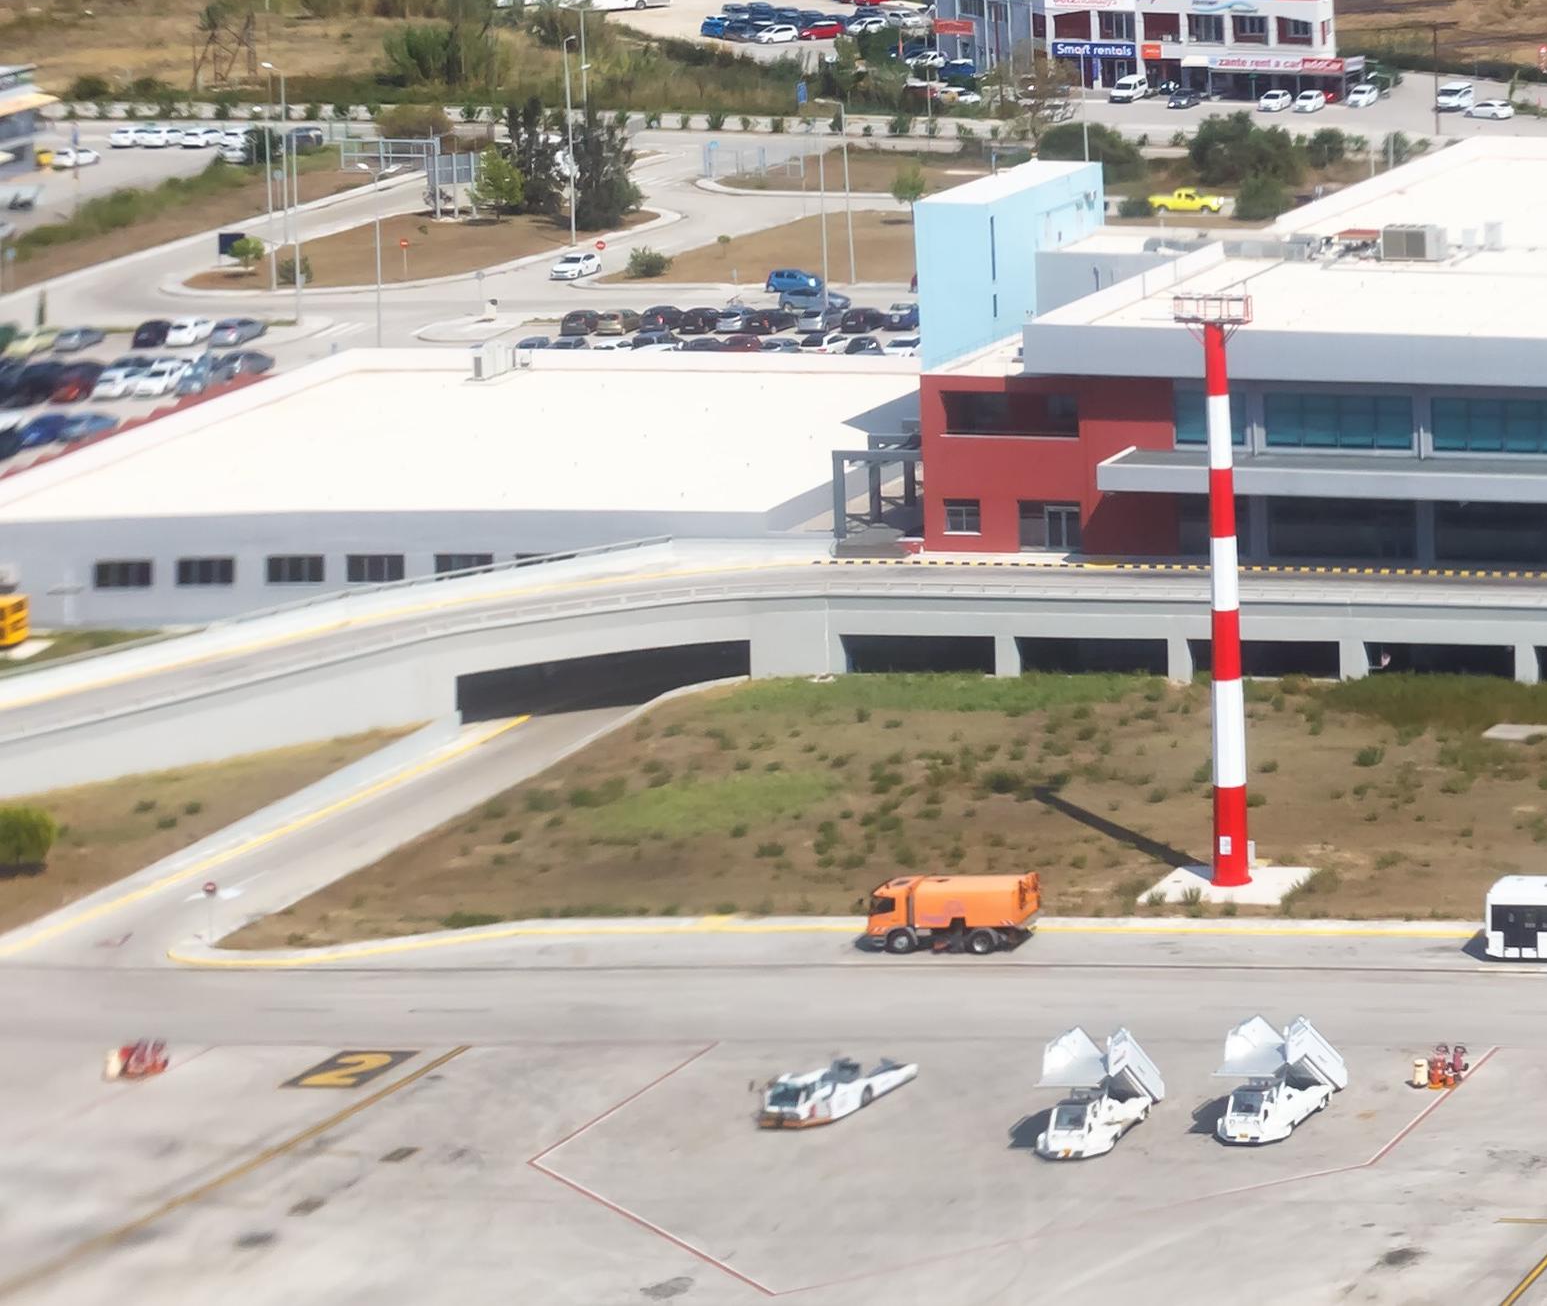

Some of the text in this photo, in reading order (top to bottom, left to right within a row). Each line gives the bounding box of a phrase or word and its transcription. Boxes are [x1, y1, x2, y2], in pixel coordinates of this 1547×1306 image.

[1056, 43, 1133, 56] Smart rentals
[1218, 57, 1248, 67] zante
[1250, 58, 1272, 68] rent
[298, 1053, 392, 1086] 2
